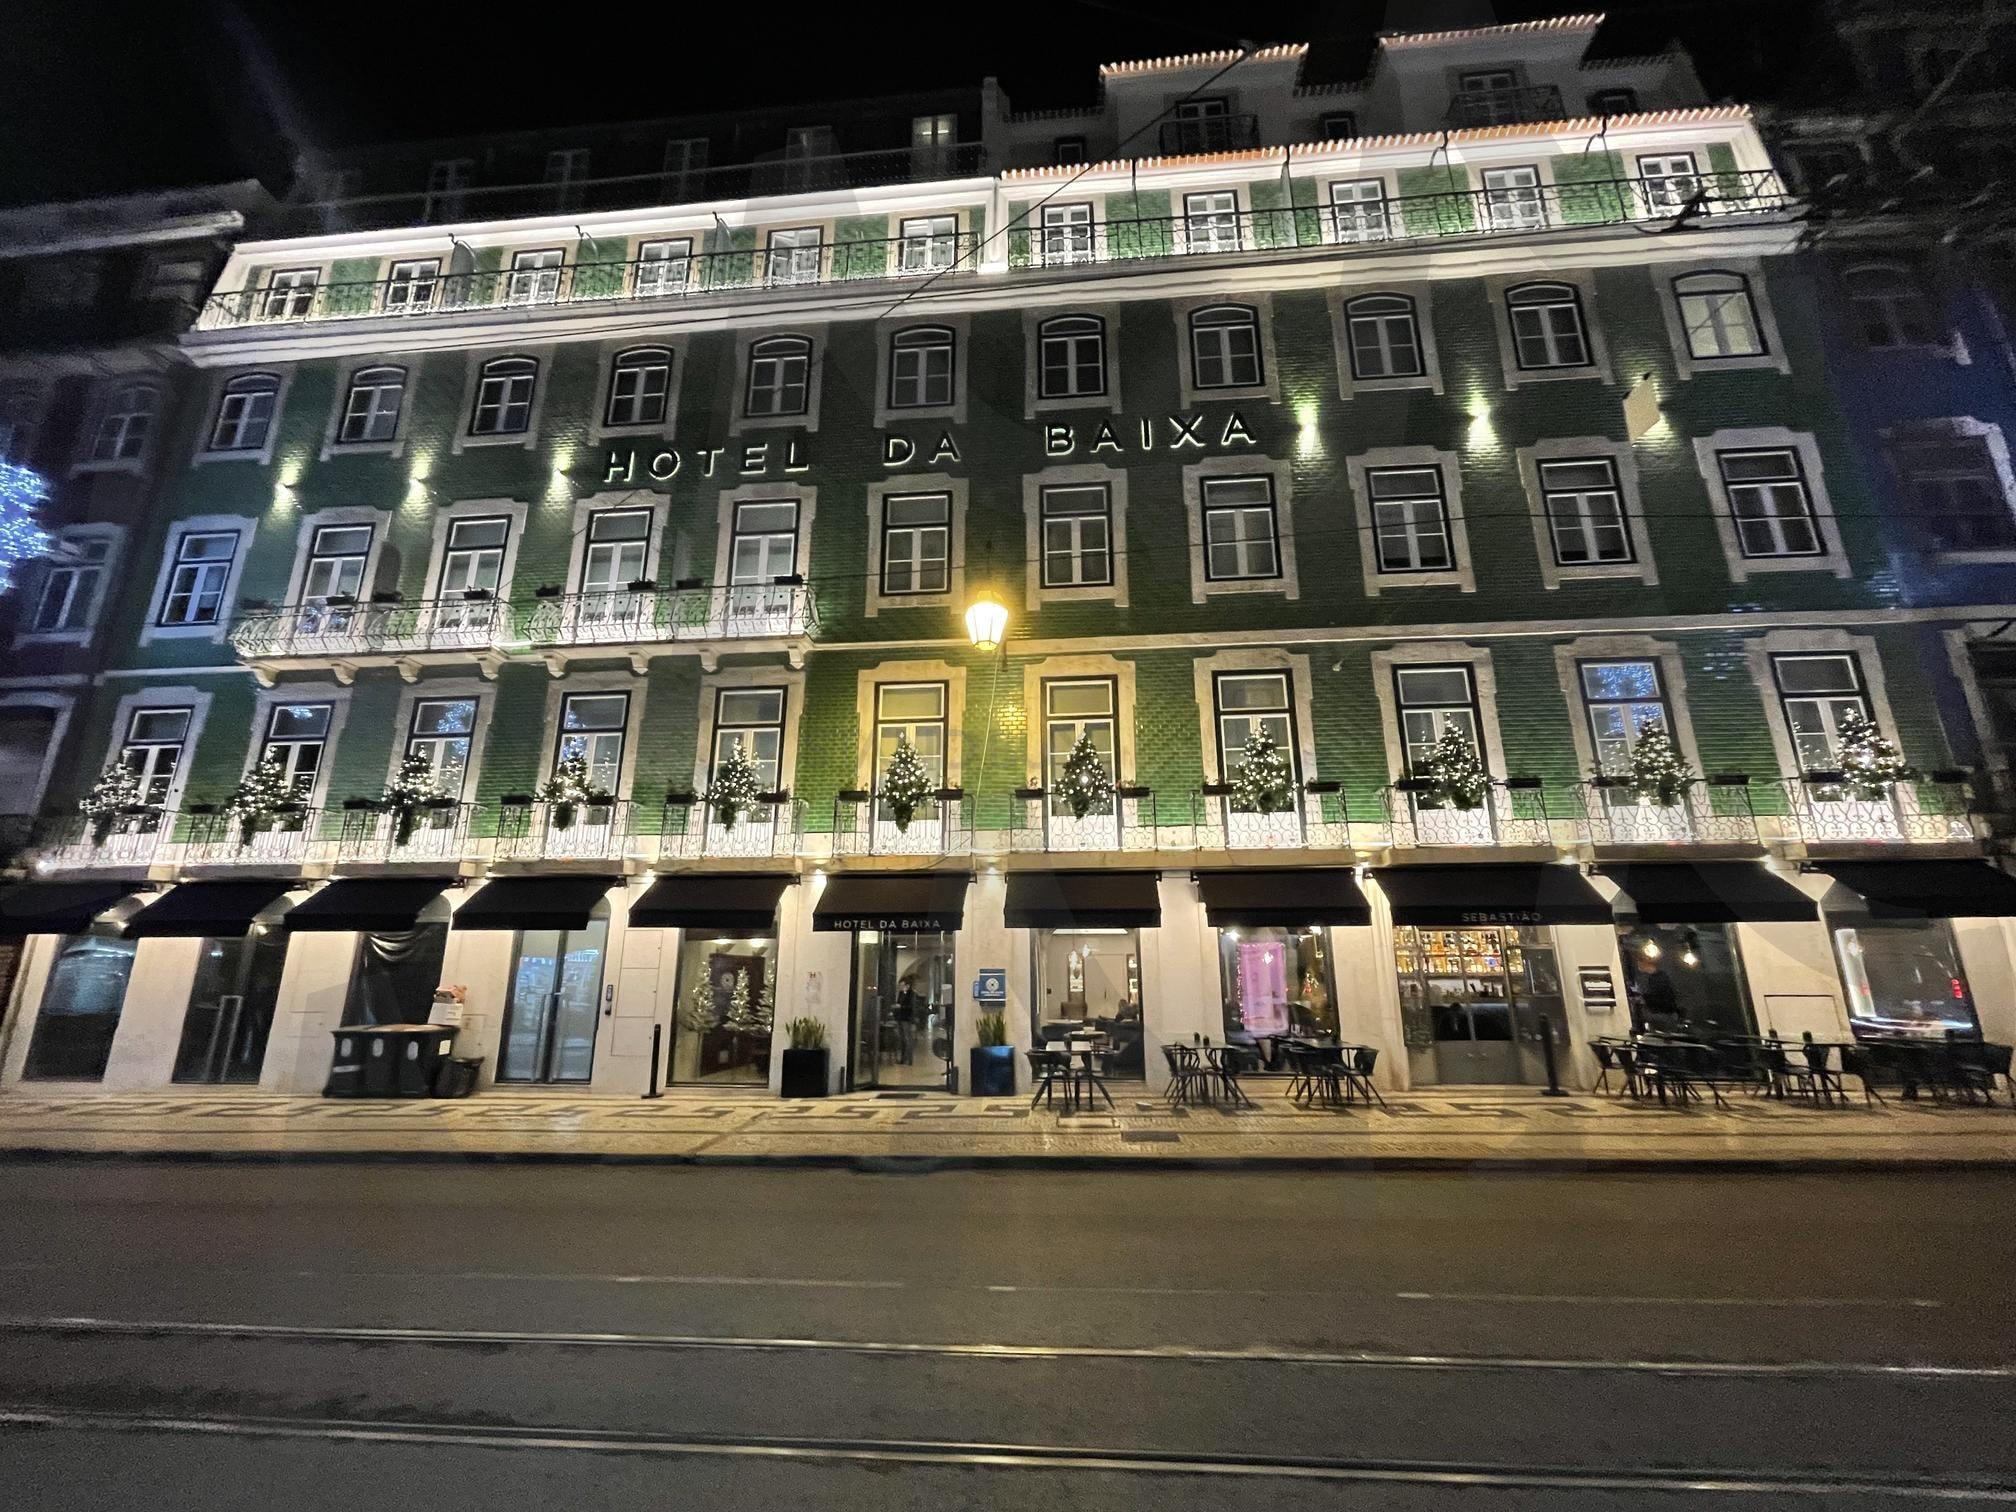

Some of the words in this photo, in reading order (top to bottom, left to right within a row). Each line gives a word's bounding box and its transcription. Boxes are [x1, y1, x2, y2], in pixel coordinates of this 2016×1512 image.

[603, 441, 810, 483] HOTEL
[882, 429, 961, 466] DA
[1044, 411, 1257, 457] BAIXA
[833, 919, 875, 929] HOTEL
[879, 919, 897, 929] DA
[901, 919, 941, 929] BAIXA
